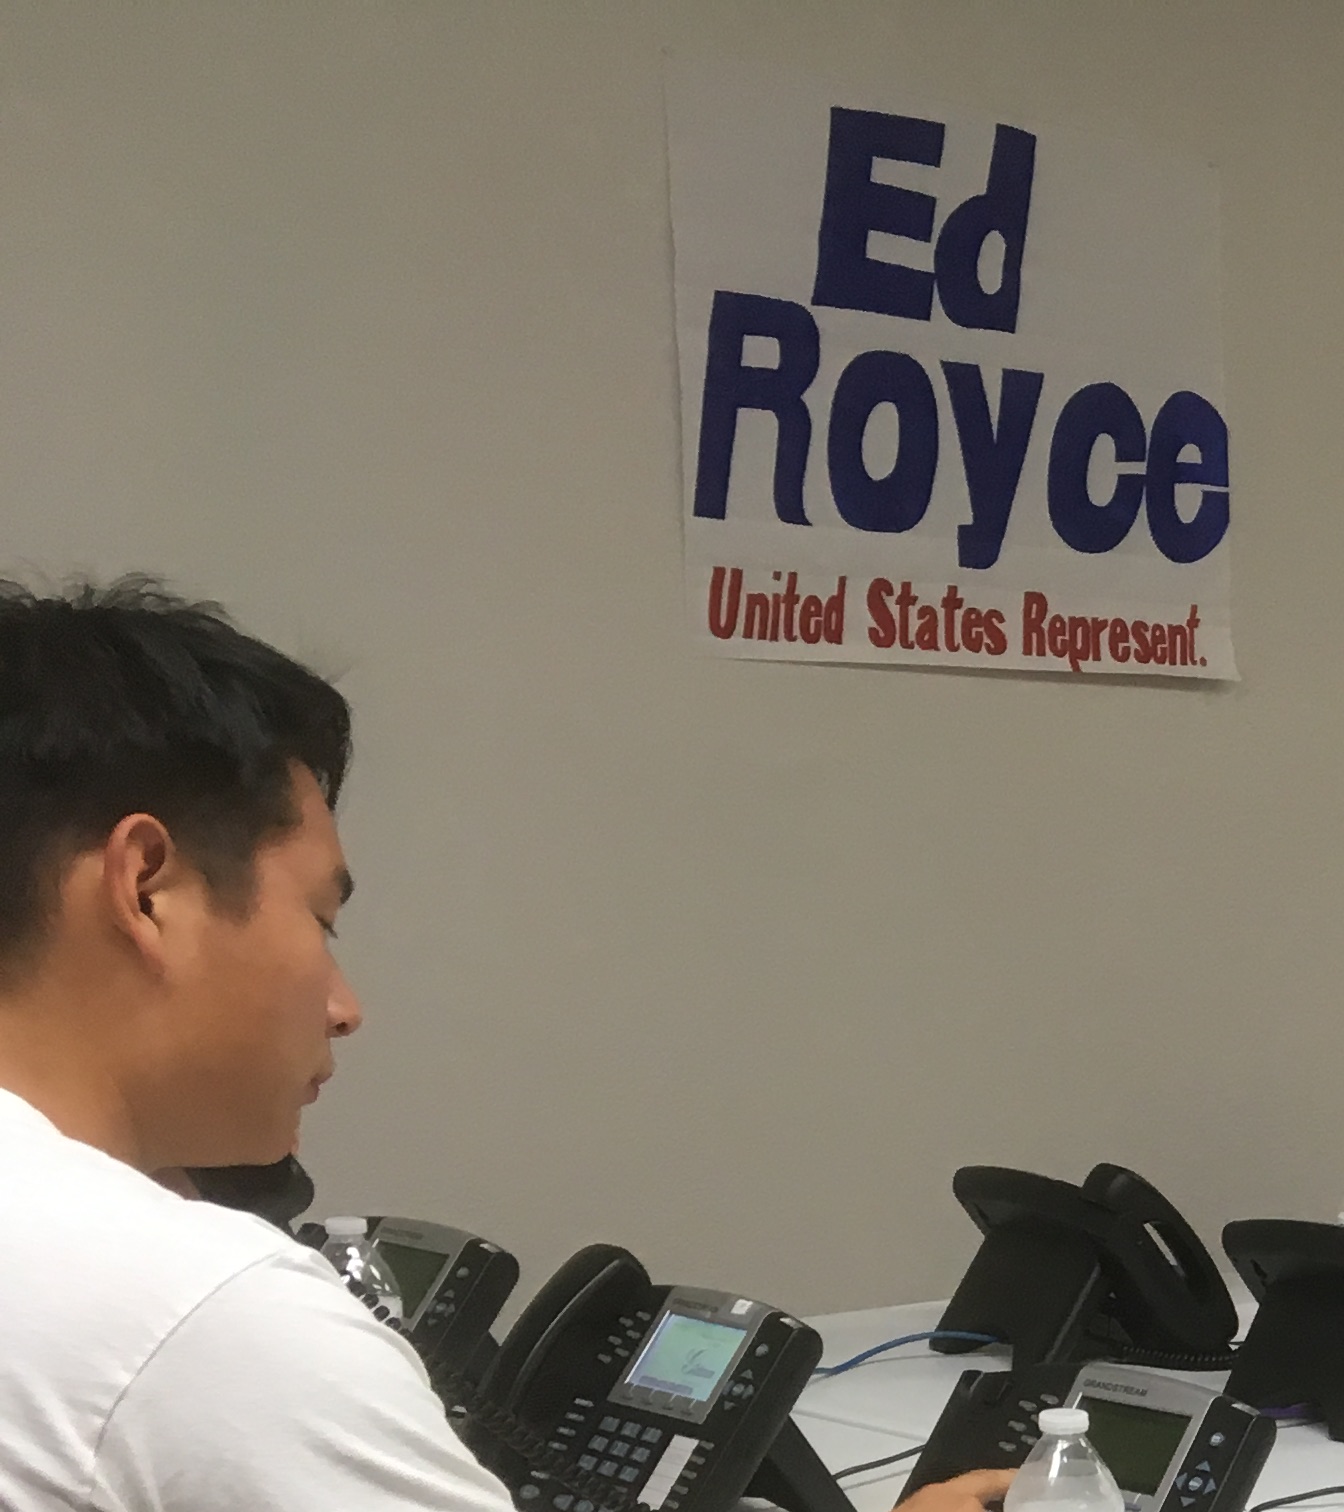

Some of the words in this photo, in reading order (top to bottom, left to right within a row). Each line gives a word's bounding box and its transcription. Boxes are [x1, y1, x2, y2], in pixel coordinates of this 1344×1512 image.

[811, 105, 1037, 334] Ed
[693, 289, 1231, 569] Royce
[707, 565, 847, 646] United
[866, 576, 1008, 656] States
[1022, 590, 1208, 673] Represent.
[1083, 1378, 1148, 1397] GRANDSTREAM
